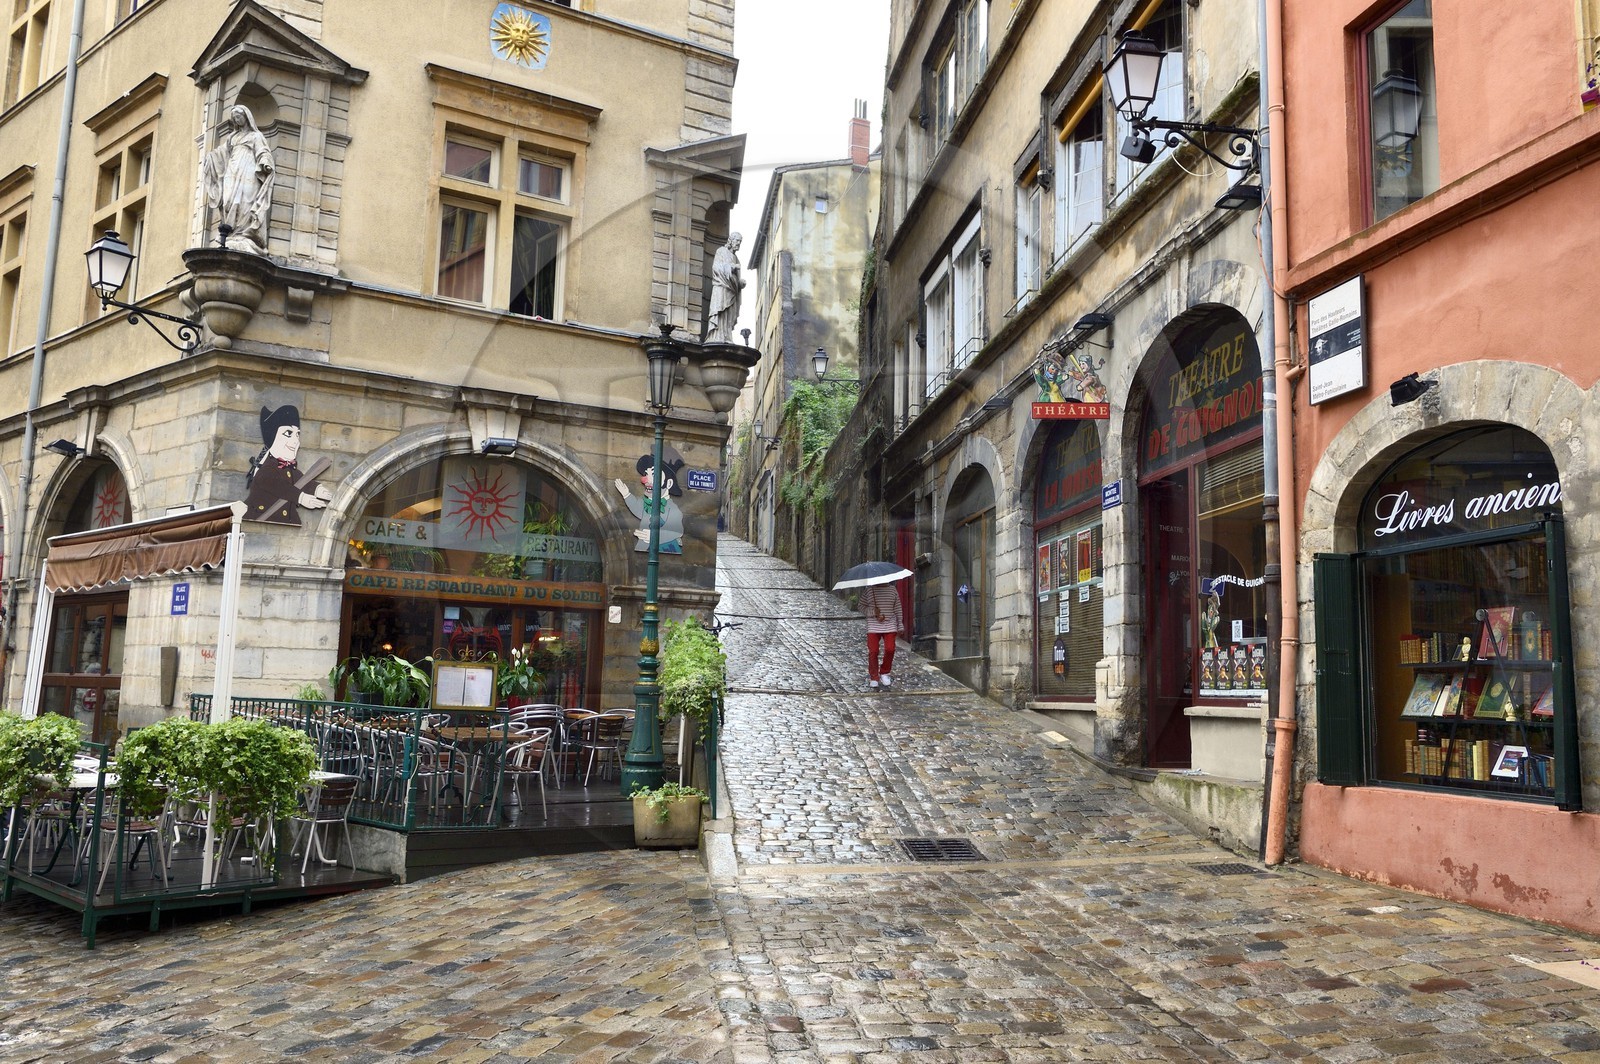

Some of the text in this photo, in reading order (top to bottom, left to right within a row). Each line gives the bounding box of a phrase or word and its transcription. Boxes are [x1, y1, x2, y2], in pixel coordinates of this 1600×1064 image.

[1312, 381, 1332, 392] Saint-Jean
[1033, 404, 1108, 415] THÉÂTRE
[1148, 376, 1263, 461] DE GUIGNOL
[693, 474, 712, 482] PLACE
[1045, 480, 1058, 509] LA
[1374, 490, 1455, 537] Livres
[415, 525, 427, 540] &
[527, 536, 595, 556] RESTAURANT
[349, 574, 603, 602] CAFE RESTAURANT DU SOLEIL
[1237, 577, 1245, 587] DE
[1054, 645, 1065, 661] Tonic
